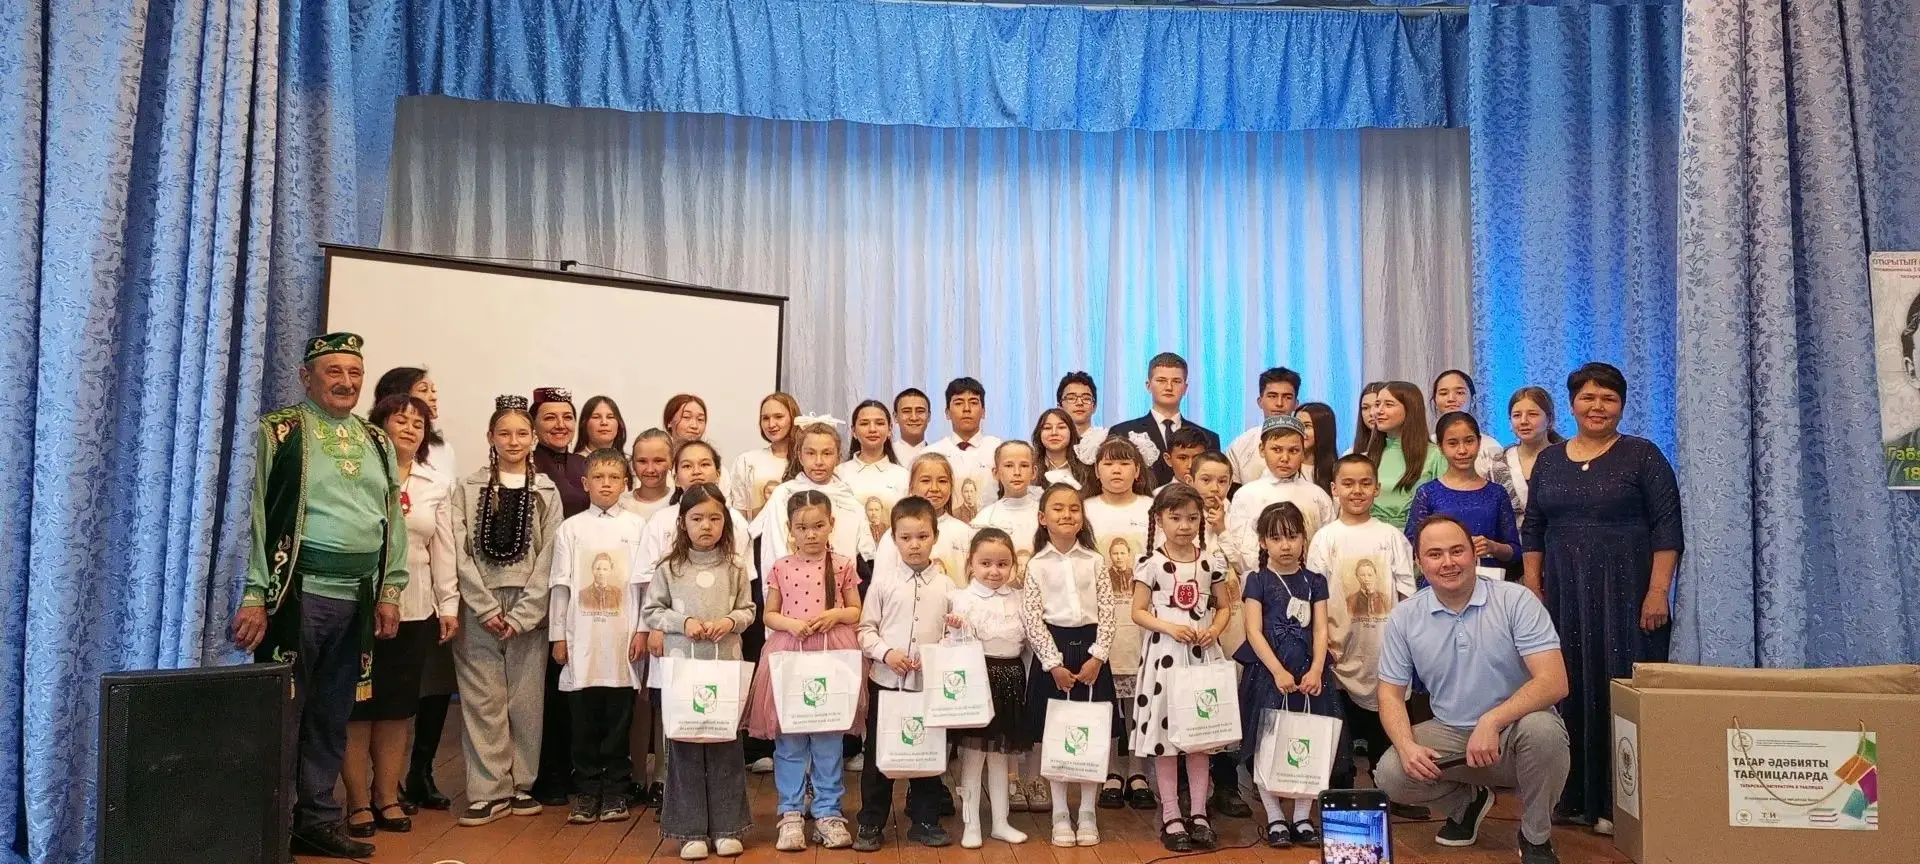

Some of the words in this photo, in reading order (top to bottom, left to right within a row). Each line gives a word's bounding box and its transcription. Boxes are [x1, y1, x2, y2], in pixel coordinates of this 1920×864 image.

[1733, 757, 1765, 766] ТАТАР
[1767, 759, 1828, 768] ӘДӘБИЯТЫ
[1734, 770, 1829, 782] ТАБЛИЦАЛАРДА
